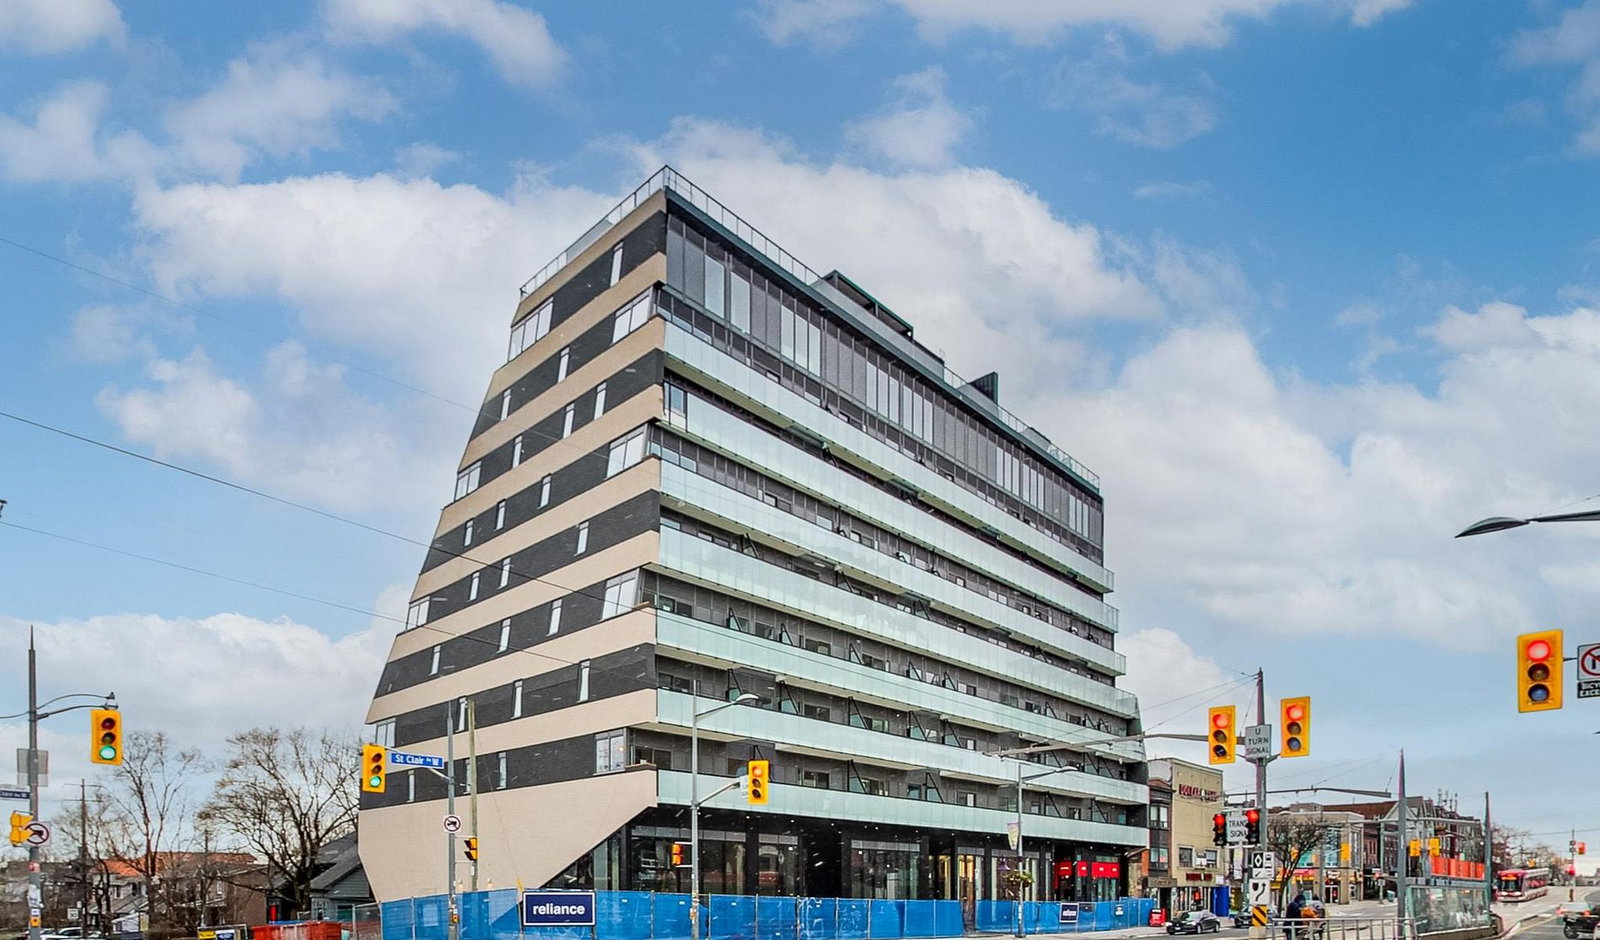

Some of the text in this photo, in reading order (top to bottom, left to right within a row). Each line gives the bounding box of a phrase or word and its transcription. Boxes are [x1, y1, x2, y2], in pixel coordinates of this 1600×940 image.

[1255, 727, 1261, 735] U
[1248, 737, 1269, 745] TURN
[1246, 746, 1270, 754] SIGNAL
[395, 754, 404, 763] St
[405, 755, 424, 765] Clair
[432, 757, 439, 766] W
[533, 903, 586, 915] reliance
